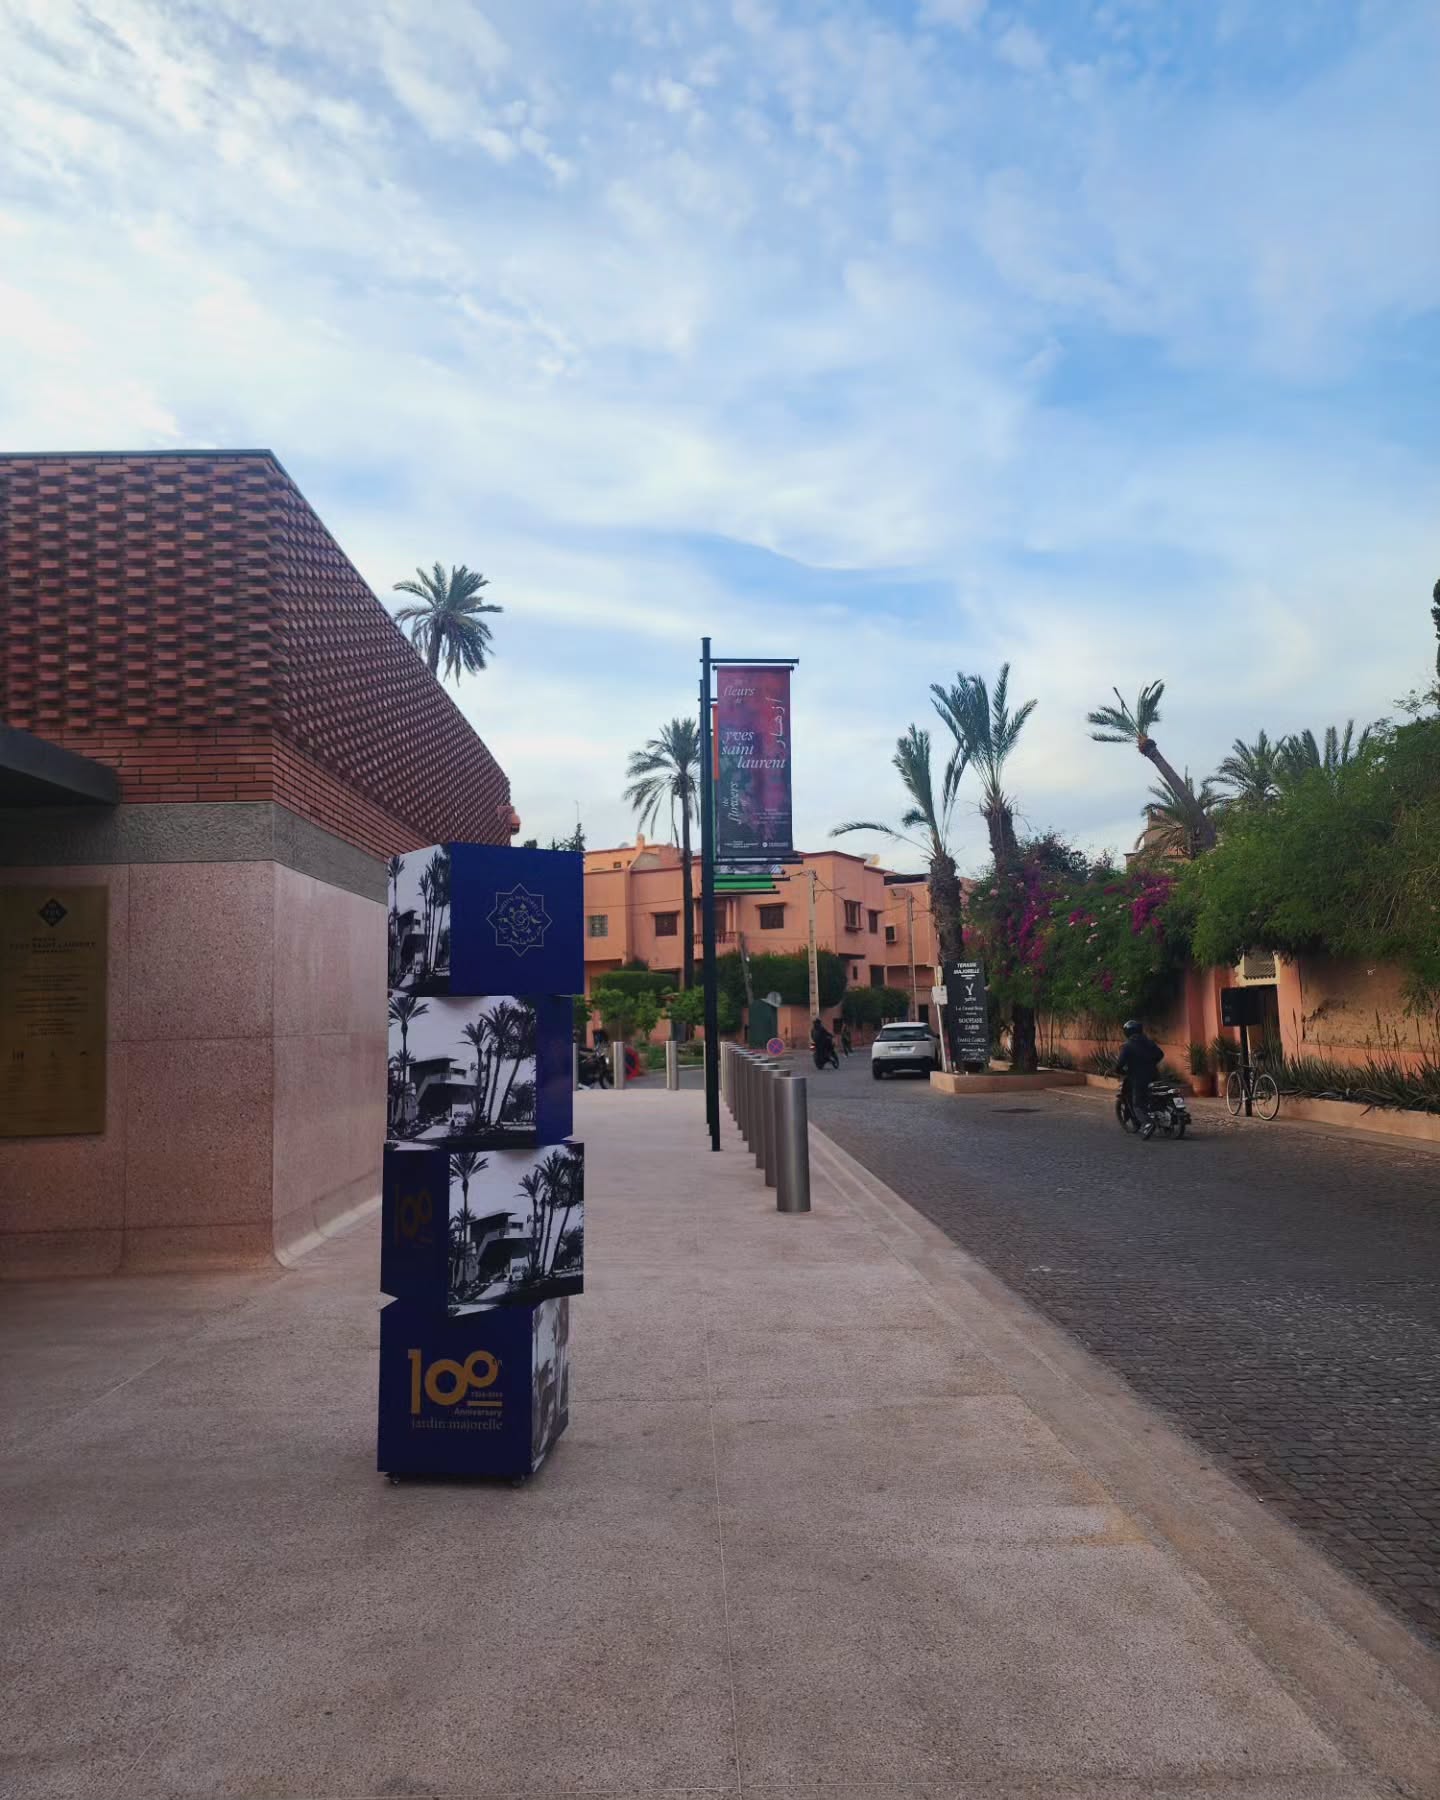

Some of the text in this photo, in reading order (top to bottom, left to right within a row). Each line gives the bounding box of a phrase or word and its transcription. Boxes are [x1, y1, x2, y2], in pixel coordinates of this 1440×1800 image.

[724, 685, 756, 697] fleurs
[725, 730, 755, 742] yves
[721, 742, 754, 755] saint
[737, 756, 786, 769] laurent
[408, 1349, 498, 1414] 100
